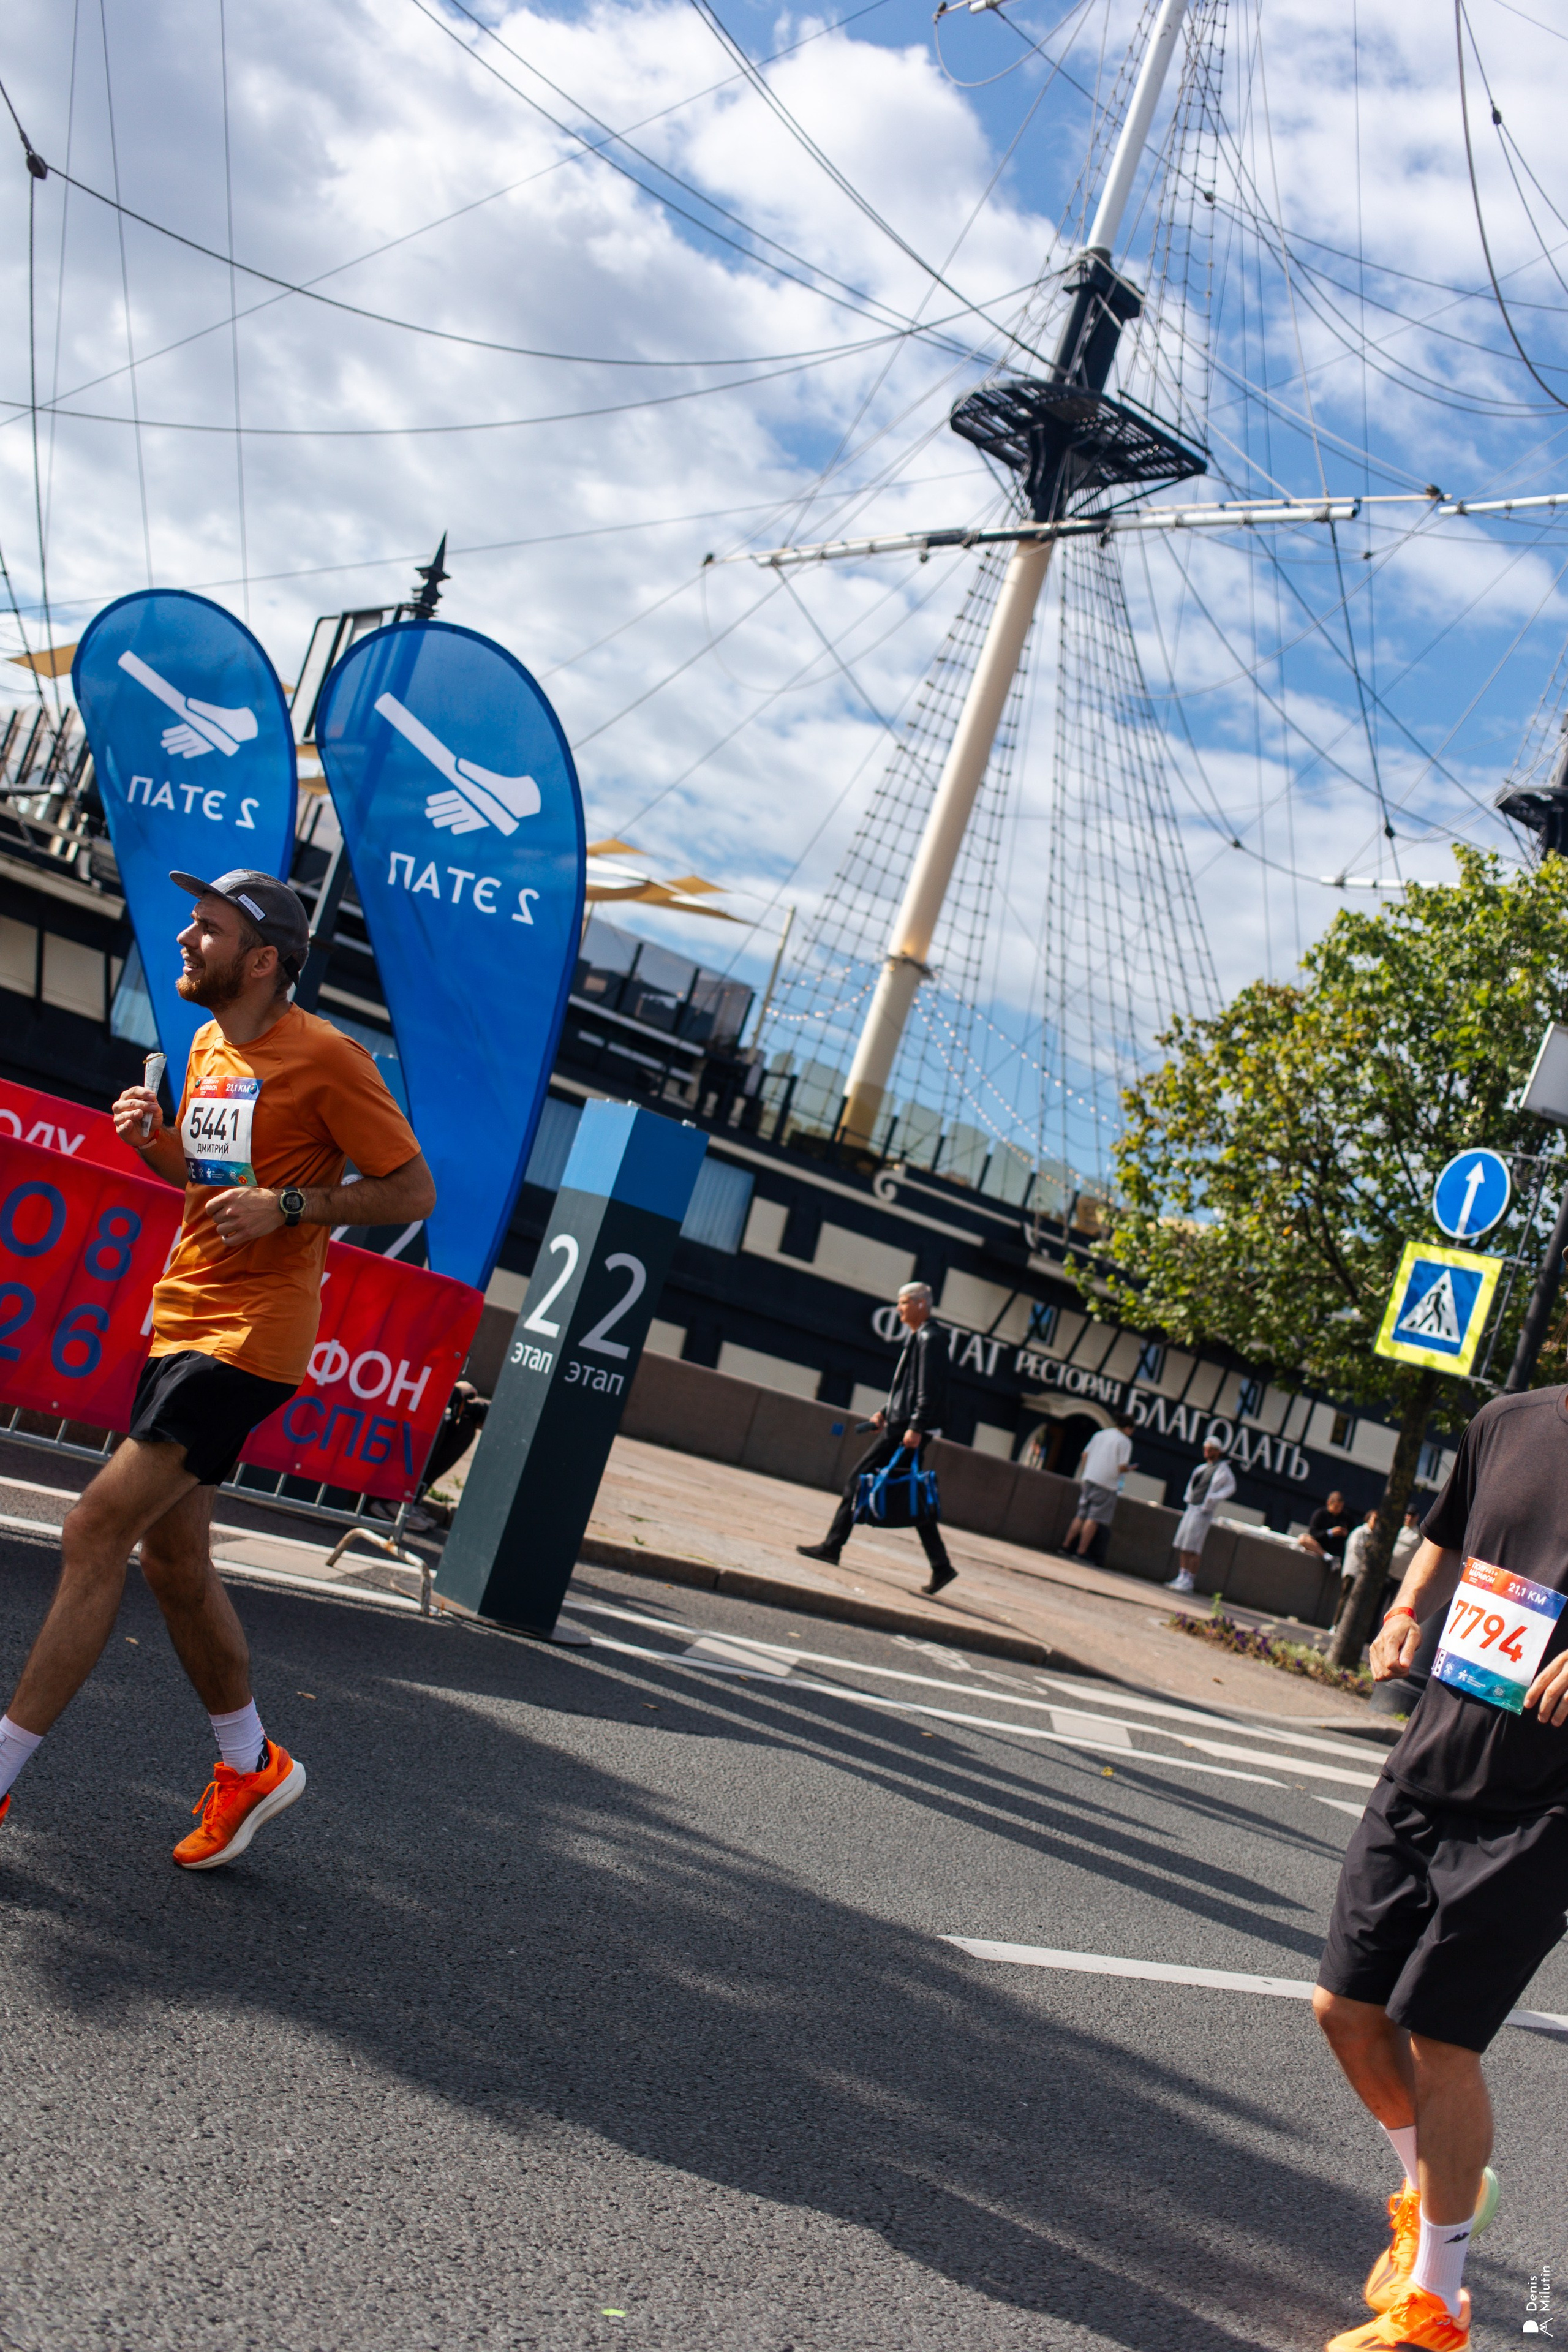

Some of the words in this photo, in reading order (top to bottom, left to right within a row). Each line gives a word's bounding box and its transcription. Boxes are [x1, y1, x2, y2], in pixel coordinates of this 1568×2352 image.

[225, 1083, 238, 1093] 21,1
[189, 1107, 239, 1142] 5441
[197, 1143, 230, 1155] ДМИТРИЙ
[523, 1233, 579, 1338] 2
[578, 1252, 647, 1360] 2
[1014, 1349, 1122, 1405] РЕСТОРАН
[1123, 1388, 1311, 1482] БЛАГОДАТЬ
[1507, 1582, 1526, 1597] 21,1
[1527, 1590, 1547, 1606] КМ
[1449, 1599, 1528, 1663] 7794
